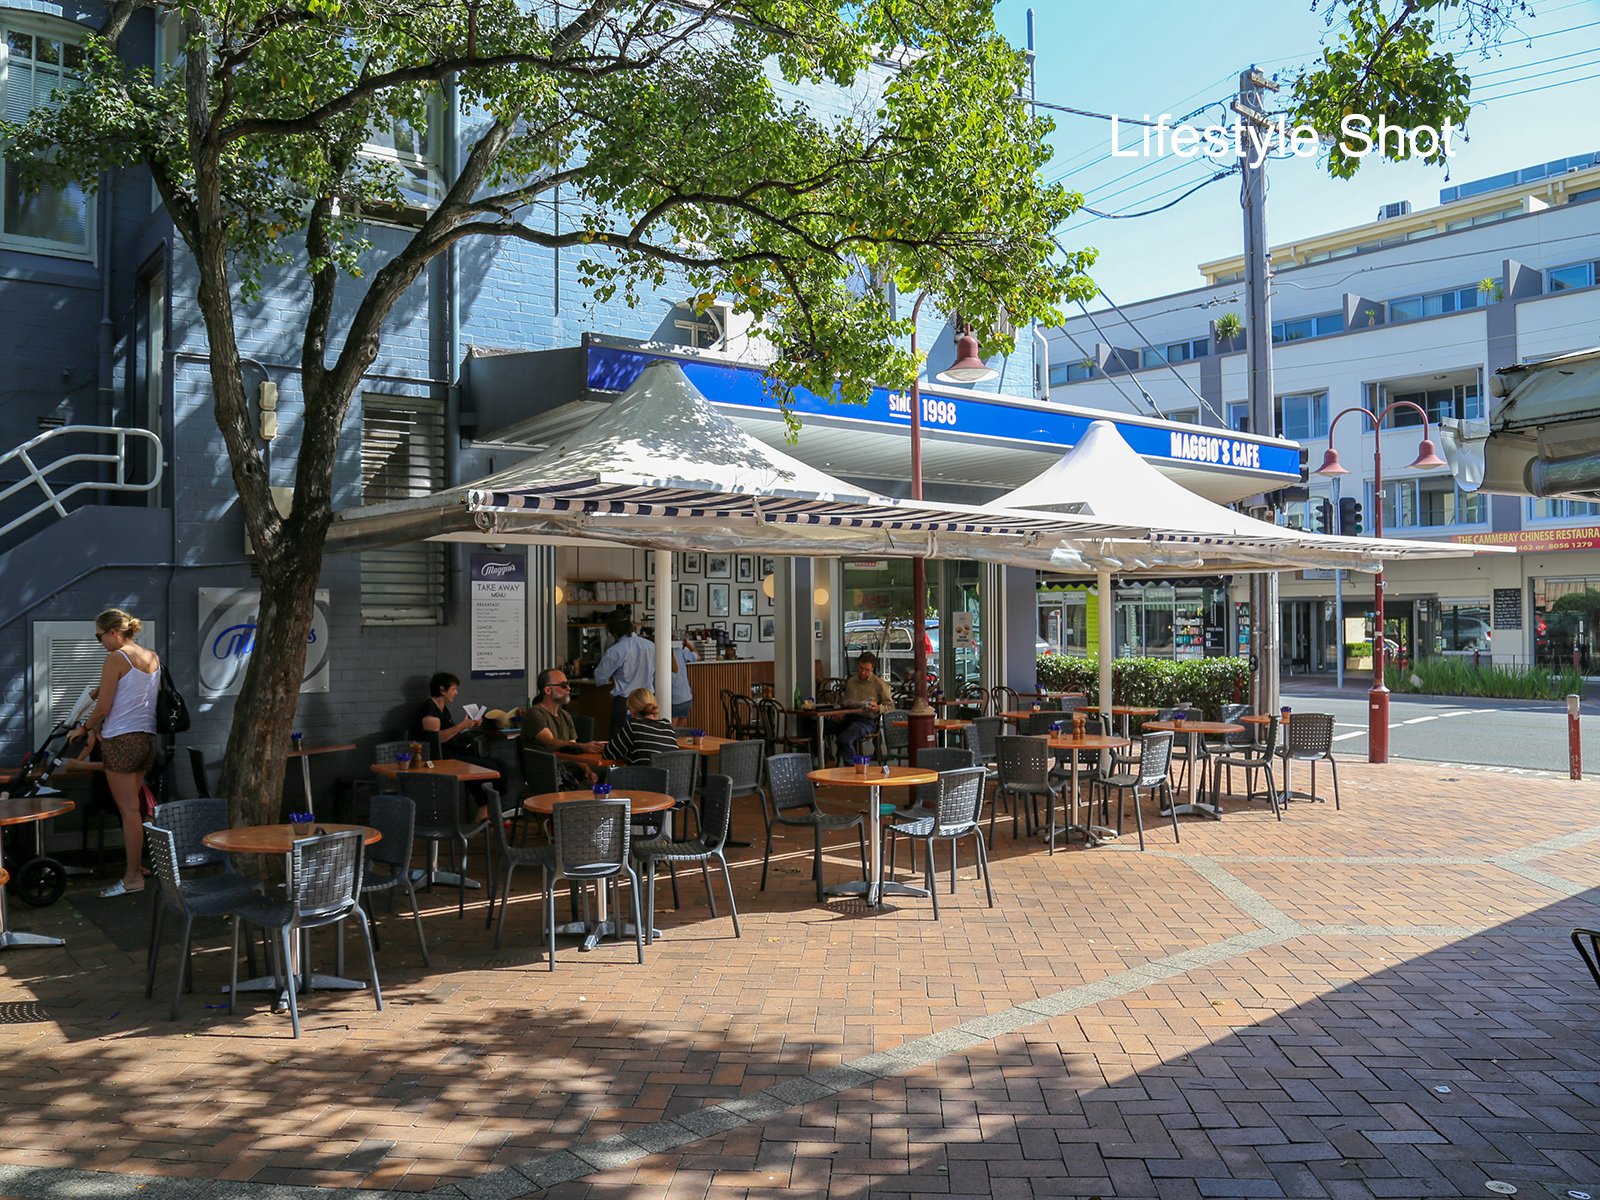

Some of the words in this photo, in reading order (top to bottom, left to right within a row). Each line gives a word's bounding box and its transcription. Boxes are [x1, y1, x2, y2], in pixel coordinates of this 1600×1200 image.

[889, 393, 911, 413] SINC
[922, 398, 957, 425] 1998
[1170, 431, 1231, 465] MAGGIO'S
[1232, 440, 1260, 468] CAFE
[1457, 535, 1473, 544] THE
[1473, 532, 1519, 544] CAMMERAY
[1519, 530, 1555, 541] CHINESE
[477, 583, 496, 592] TAKE
[498, 584, 520, 592] AWAY
